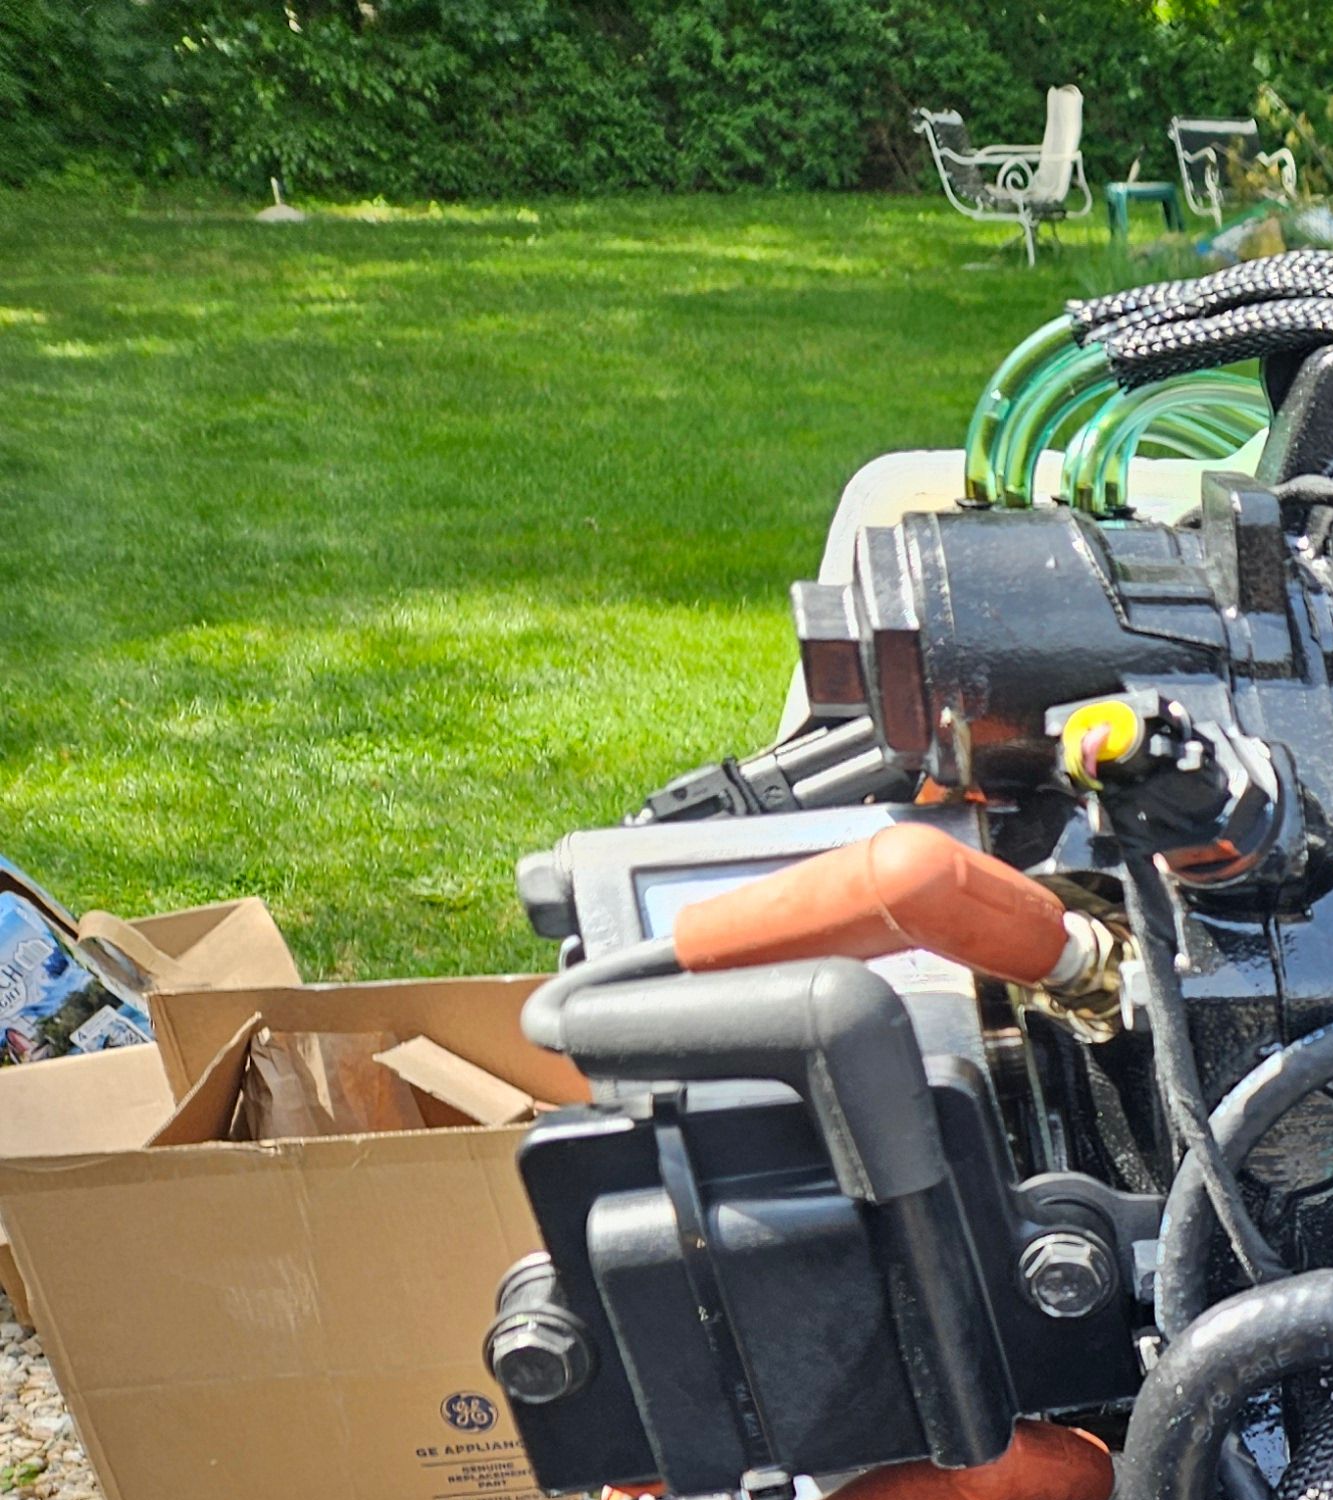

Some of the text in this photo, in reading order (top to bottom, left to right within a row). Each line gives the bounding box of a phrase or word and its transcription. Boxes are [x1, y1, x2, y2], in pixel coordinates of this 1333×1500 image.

[416, 1447, 439, 1457] GE
[462, 1462, 514, 1475] GENUINE
[478, 1479, 508, 1489] PART
